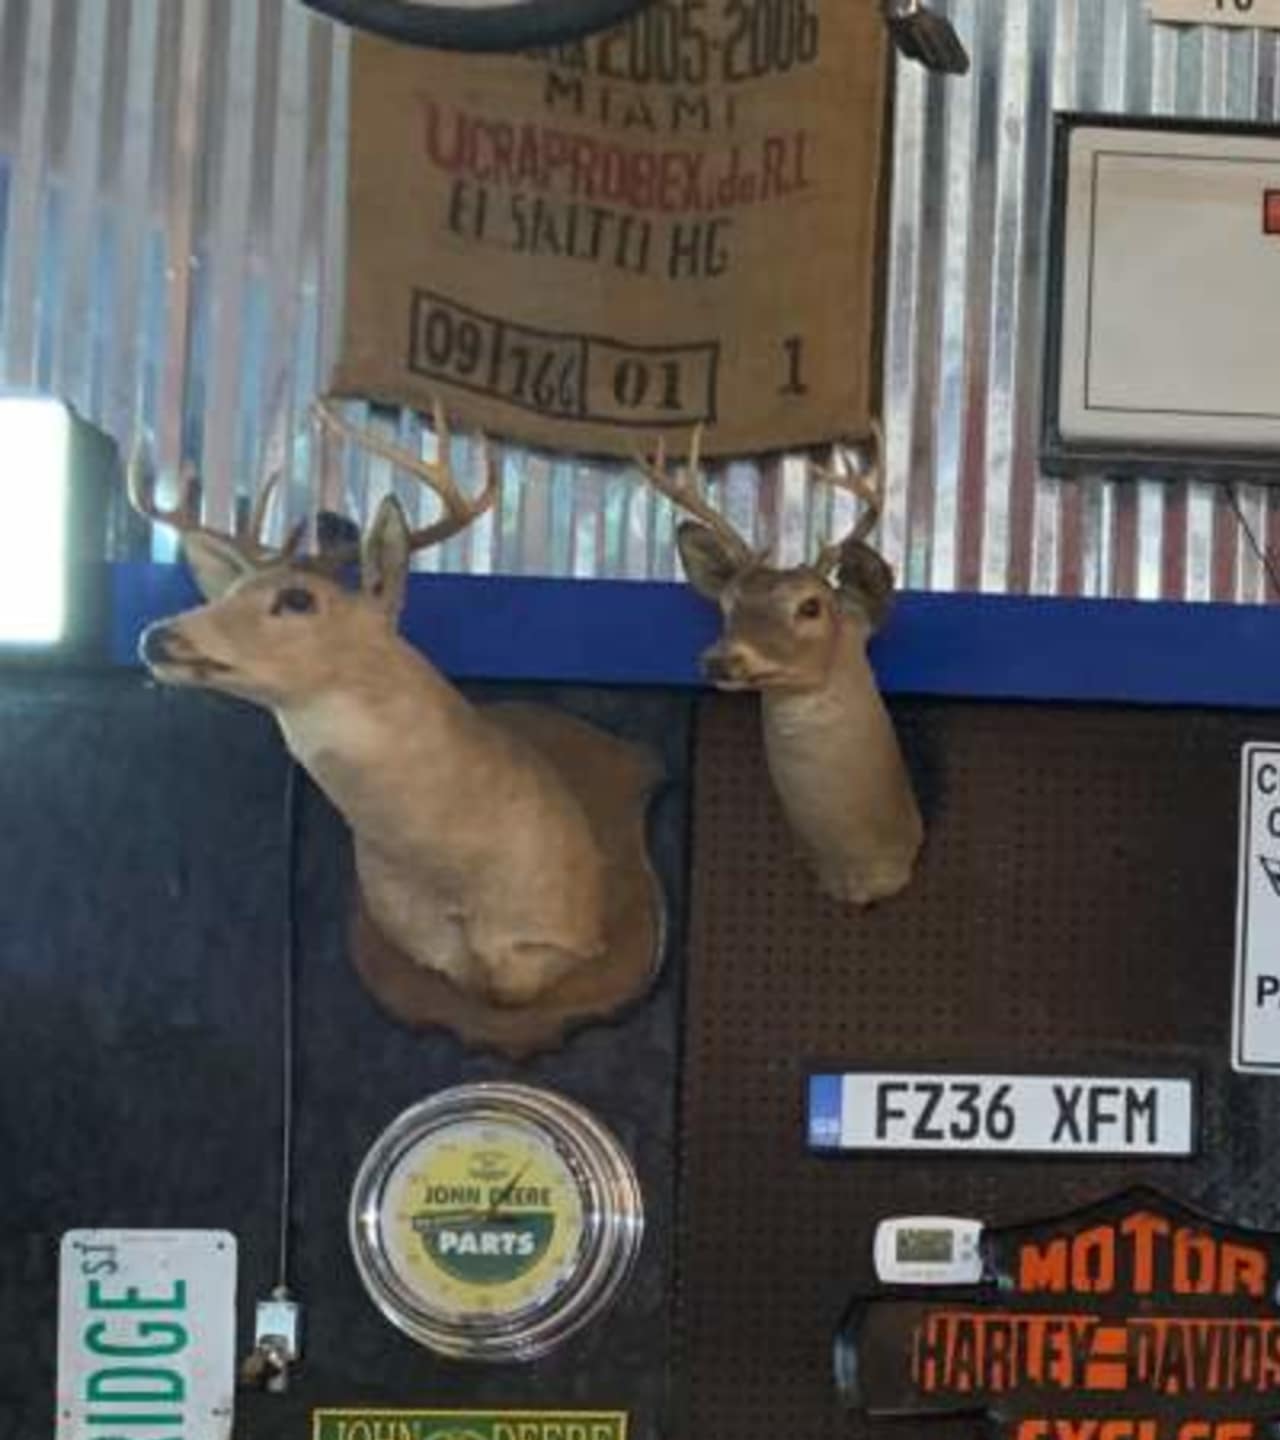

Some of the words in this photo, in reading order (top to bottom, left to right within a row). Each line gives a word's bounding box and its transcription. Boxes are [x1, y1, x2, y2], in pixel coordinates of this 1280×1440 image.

[543, 72, 736, 132] MIAMI
[424, 310, 475, 375] 09
[613, 357, 683, 410] 01
[779, 336, 808, 396] 1
[875, 1083, 1015, 1141] FZ36
[1051, 1085, 1157, 1145] XFM
[438, 1231, 536, 1256] PARTS
[1020, 1211, 1267, 1295] MOTOR
